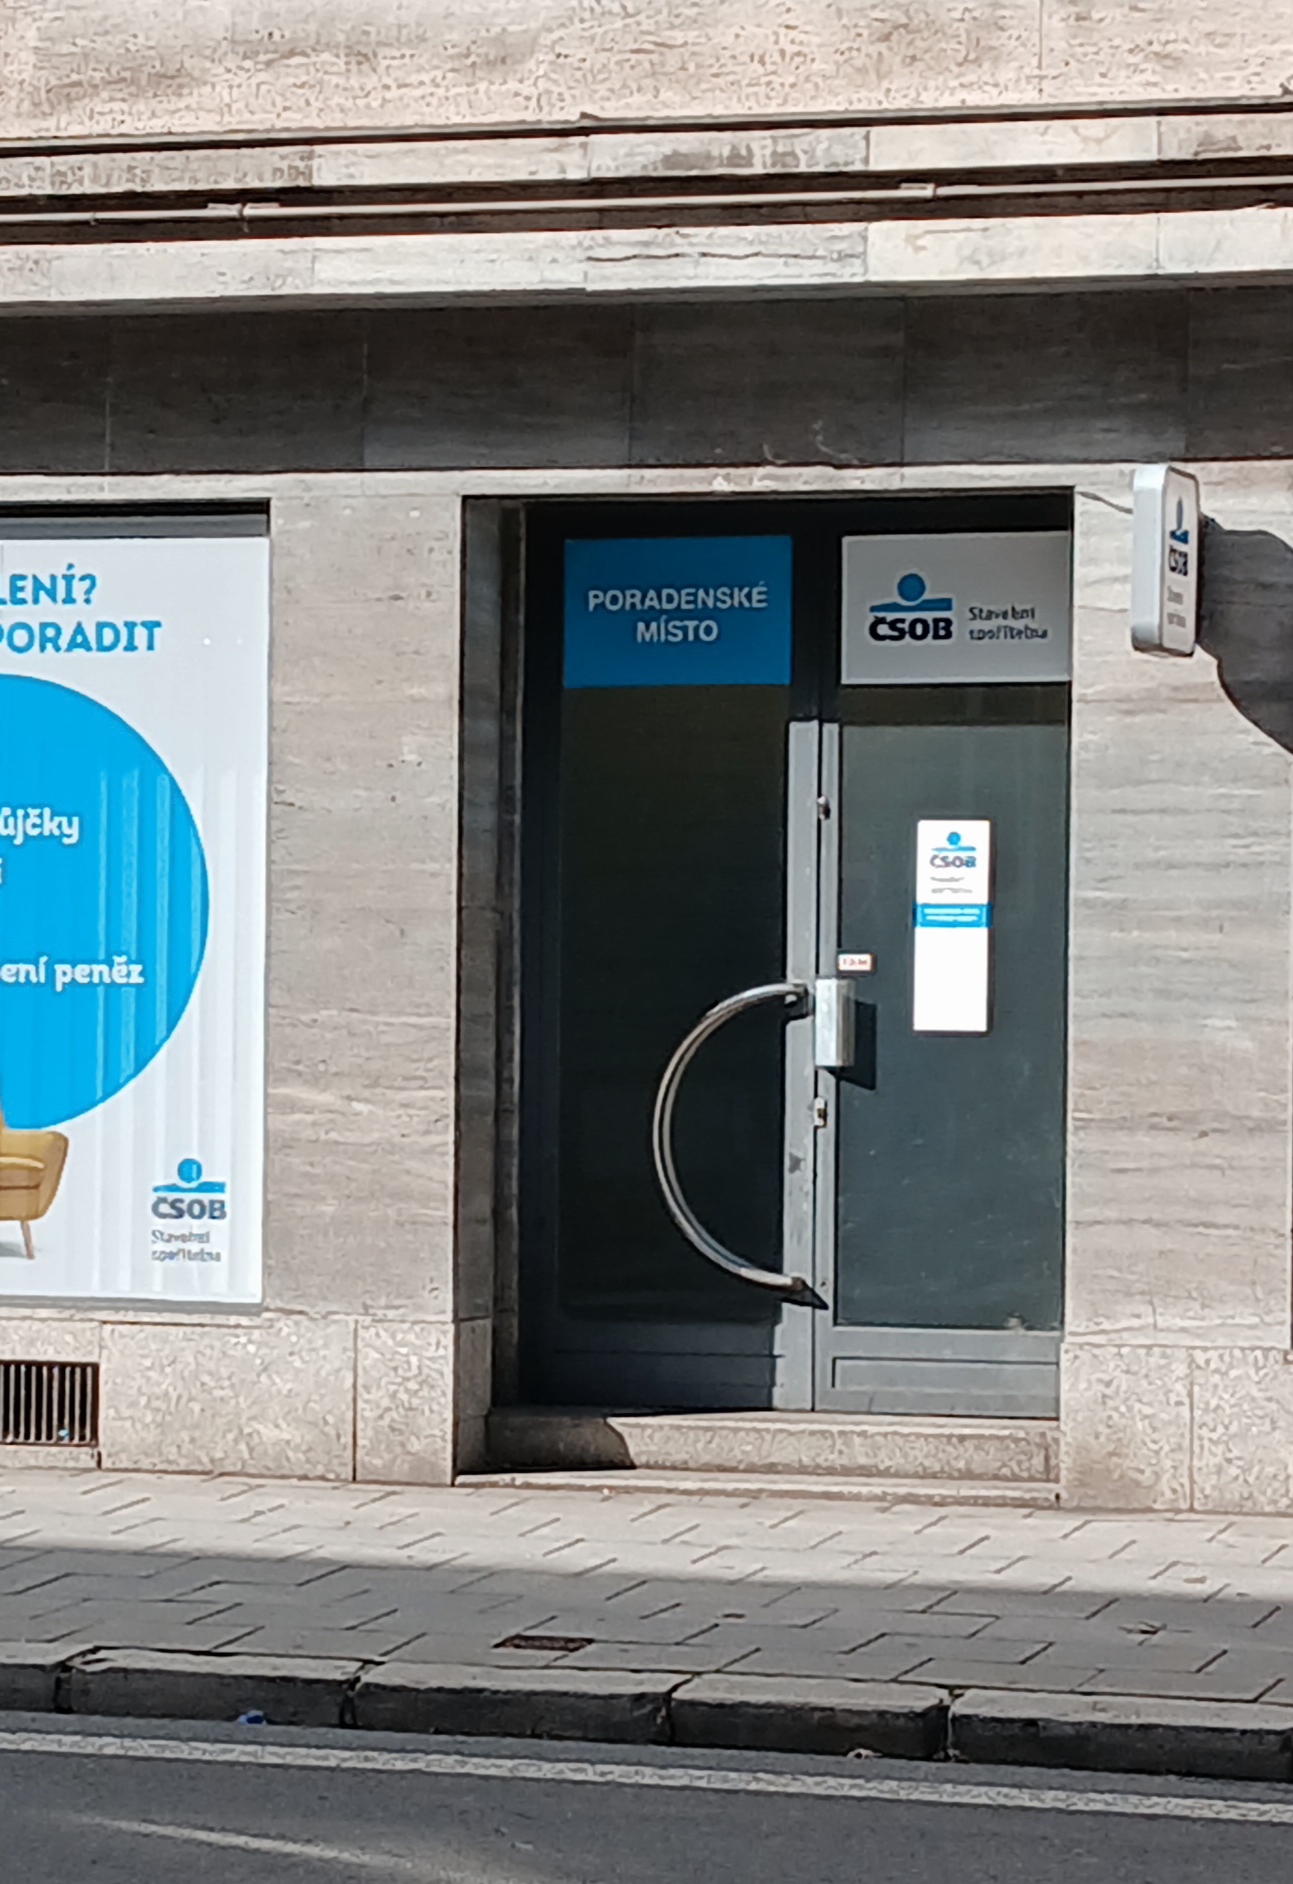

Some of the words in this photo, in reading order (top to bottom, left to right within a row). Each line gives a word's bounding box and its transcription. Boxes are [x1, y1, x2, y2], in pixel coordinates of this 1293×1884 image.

[587, 581, 769, 612] PORADENSKÉ
[636, 614, 719, 643] MÍSTO
[868, 613, 953, 642] ČSOB
[54, 955, 145, 991] peněz
[150, 1196, 228, 1220] ČSOB
